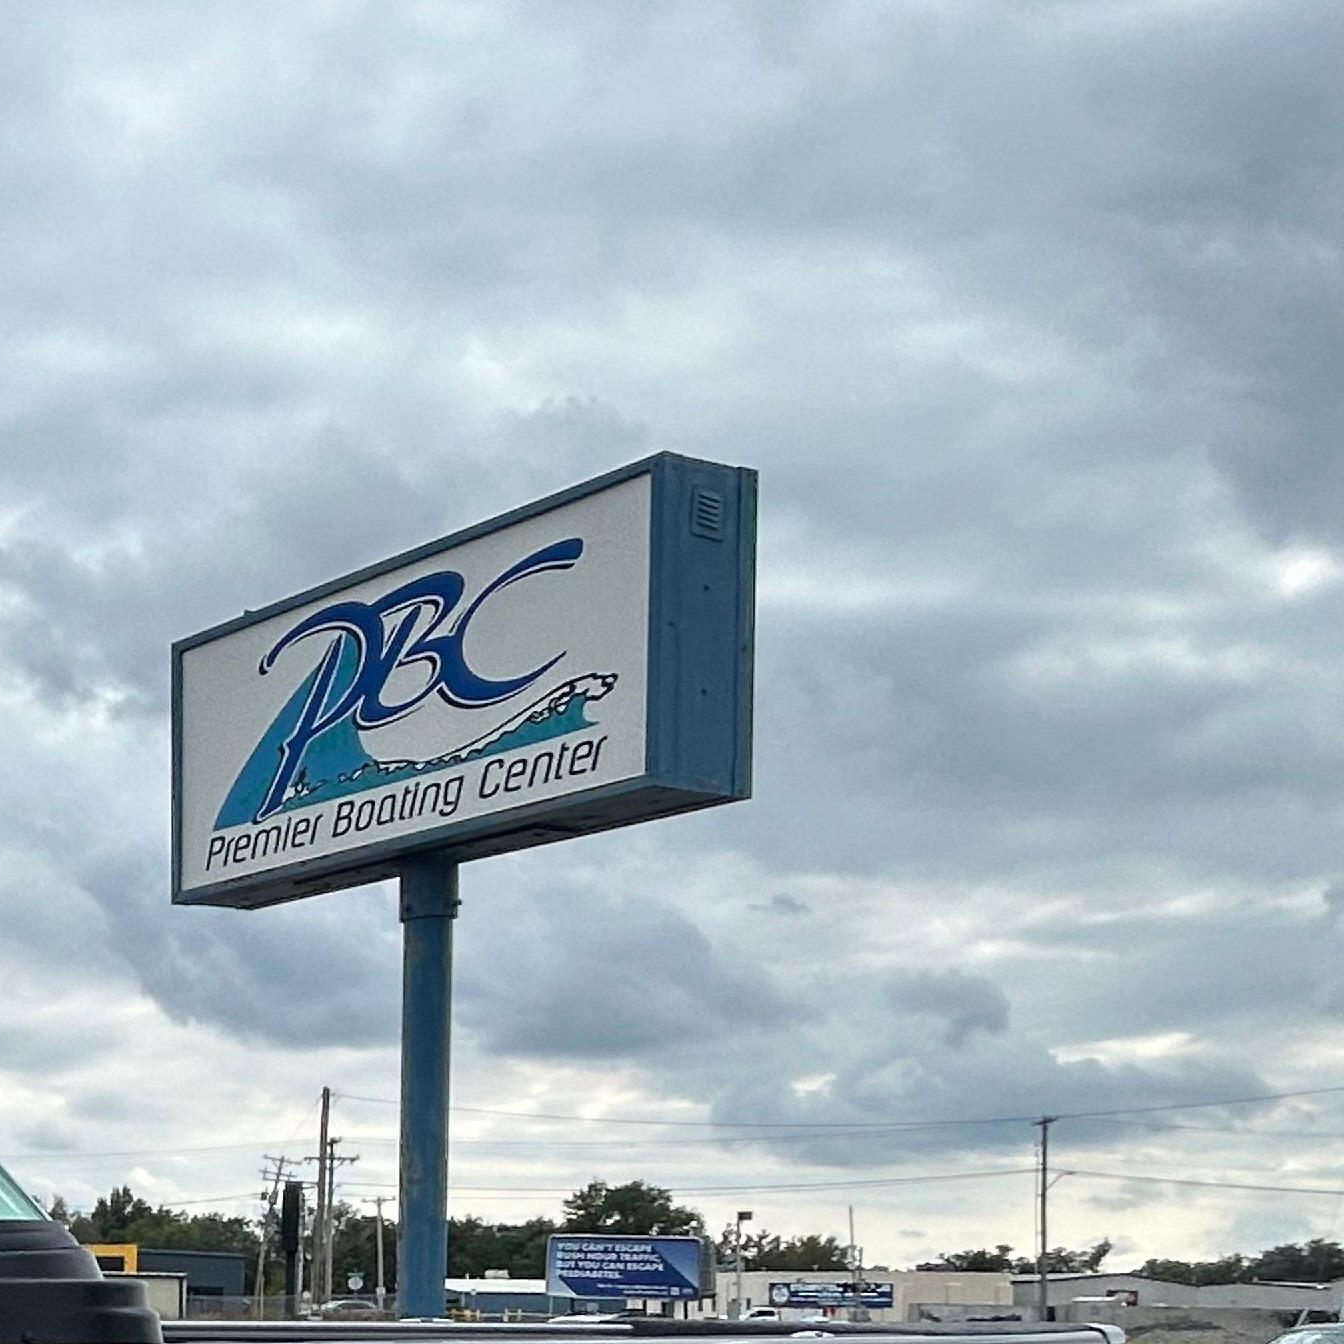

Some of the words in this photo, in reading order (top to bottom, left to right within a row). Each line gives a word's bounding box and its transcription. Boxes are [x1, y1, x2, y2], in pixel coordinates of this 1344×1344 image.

[259, 537, 584, 825] PBC
[205, 814, 325, 872] Premier
[331, 774, 465, 838] Boating
[478, 735, 609, 799] Center
